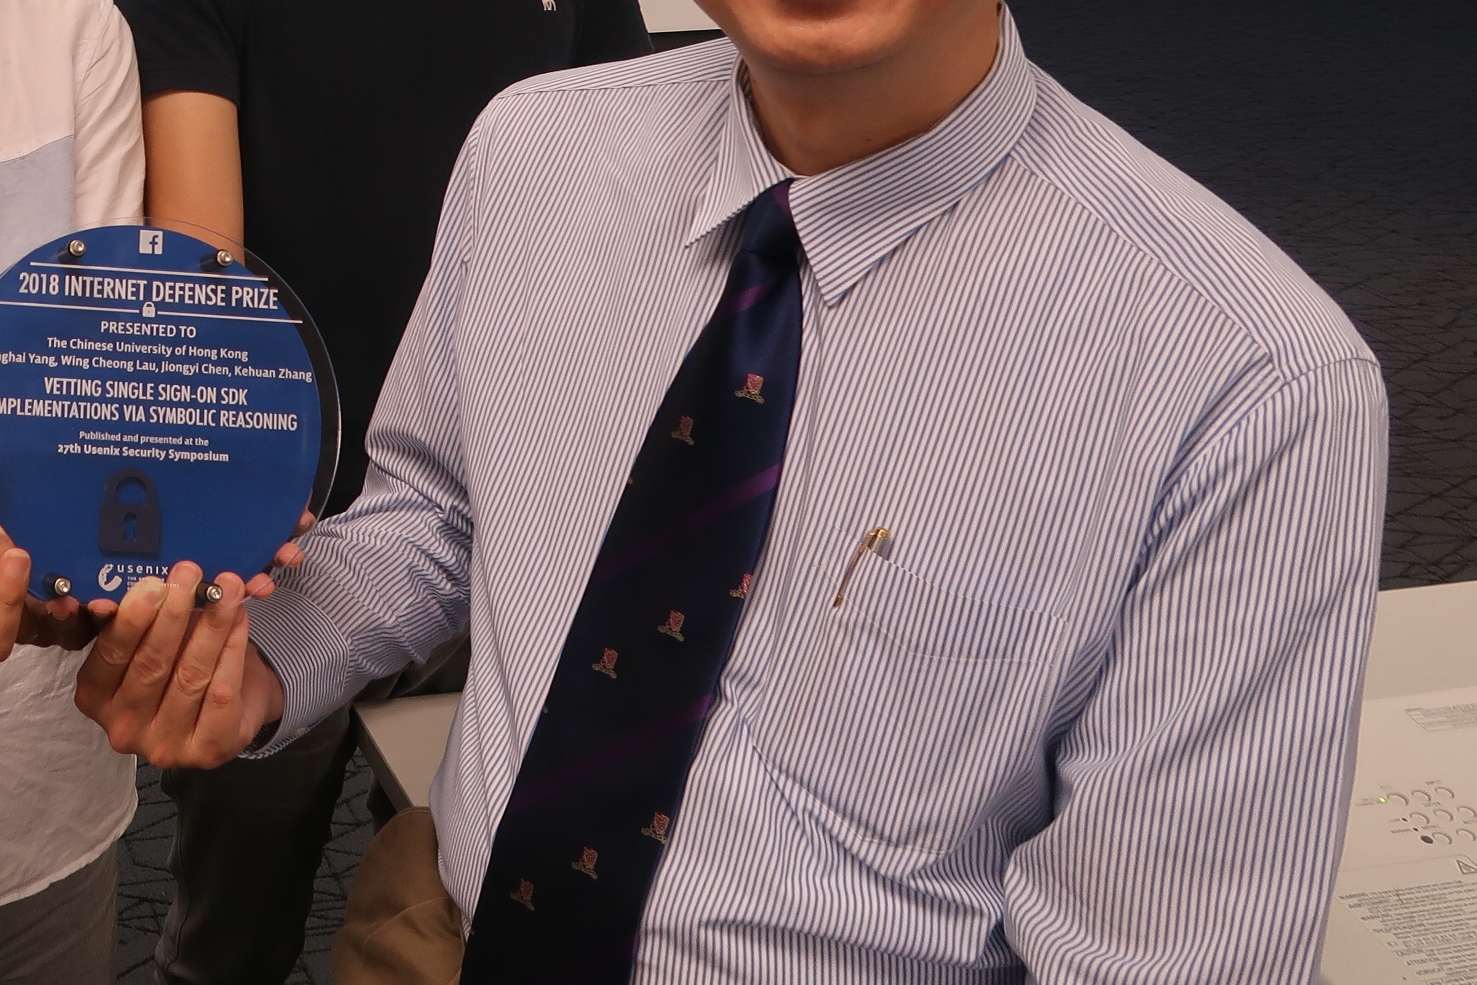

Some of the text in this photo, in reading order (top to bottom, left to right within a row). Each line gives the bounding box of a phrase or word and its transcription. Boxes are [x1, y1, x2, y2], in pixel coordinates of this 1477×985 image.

[19, 272, 278, 310] 2018 INTERNET DEFENSE PRIZE
[100, 320, 197, 339] PRESENTED TO
[47, 336, 248, 362] The Chinese University of Hong Kong
[27, 351, 59, 368] Yang,
[61, 354, 90, 371] Wing
[92, 356, 134, 373] Cheong
[136, 358, 159, 373] Lau,
[161, 360, 199, 376] Jiongyi
[201, 362, 232, 376] Chen,
[234, 364, 276, 379] Kehuan
[278, 367, 313, 383] Zhang
[44, 376, 248, 406] VETTING SINGLE SIGN-ON SDK
[124, 402, 146, 422] VIA
[150, 404, 216, 427] SYMBOLIC
[220, 408, 298, 432] REASONING
[79, 430, 209, 447] Published and presented at the
[58, 444, 229, 463] 27th Usenix Security Symposium
[117, 564, 169, 575] usenix
